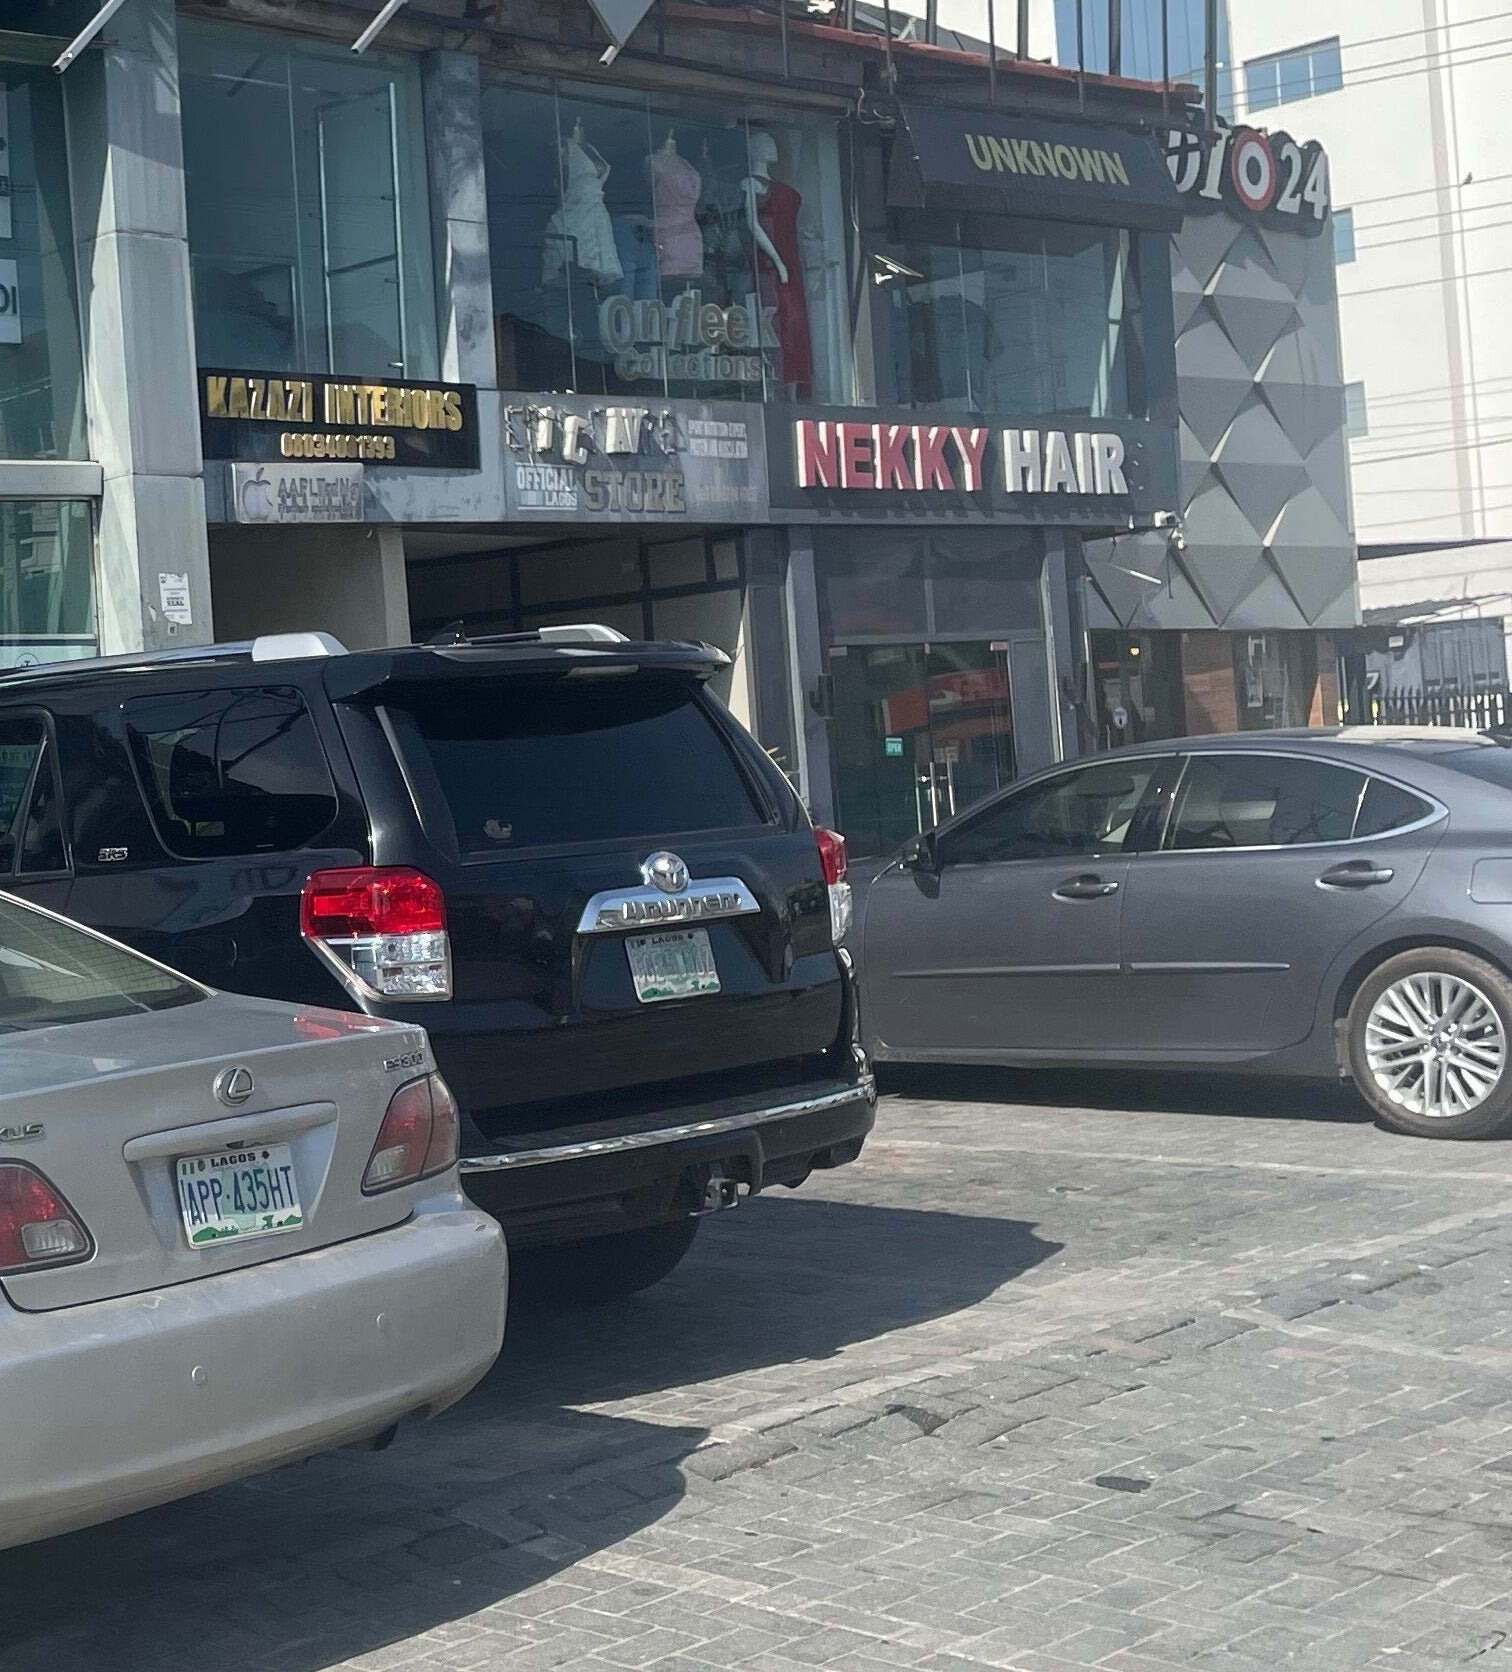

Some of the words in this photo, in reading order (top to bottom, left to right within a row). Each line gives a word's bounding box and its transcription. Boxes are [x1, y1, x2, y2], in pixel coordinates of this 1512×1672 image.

[965, 133, 1130, 186] UNKNOWN
[207, 376, 314, 423] KAZAZI
[324, 382, 463, 431] INTERIORS
[795, 420, 988, 492] NEKKY
[1003, 430, 1129, 495] HAIR
[517, 467, 577, 491] OFFICIAL
[585, 470, 686, 513] STORE
[545, 491, 578, 506] LAGOS
[210, 1152, 257, 1168] LAGOS
